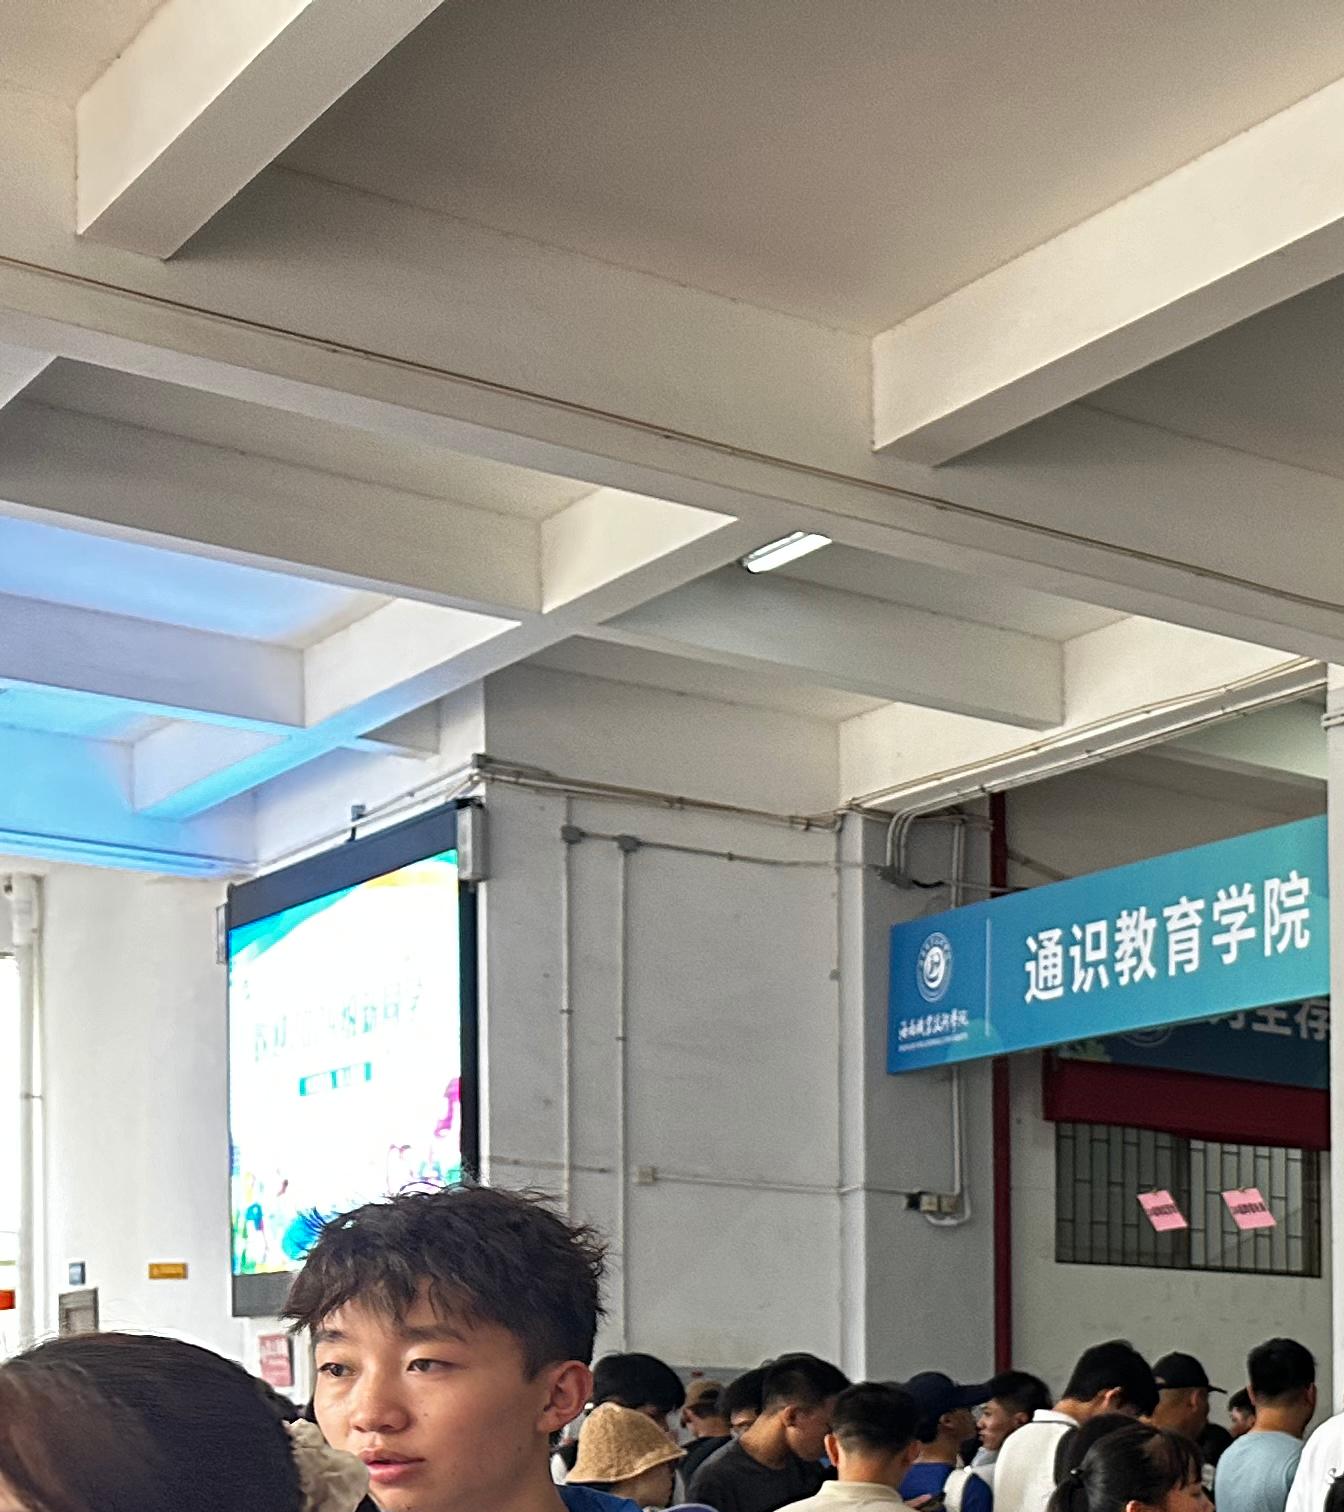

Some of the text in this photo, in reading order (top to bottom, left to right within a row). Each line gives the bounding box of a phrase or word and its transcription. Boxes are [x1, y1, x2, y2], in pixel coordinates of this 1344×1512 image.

[1024, 870, 1311, 1003] 通识教育学院
